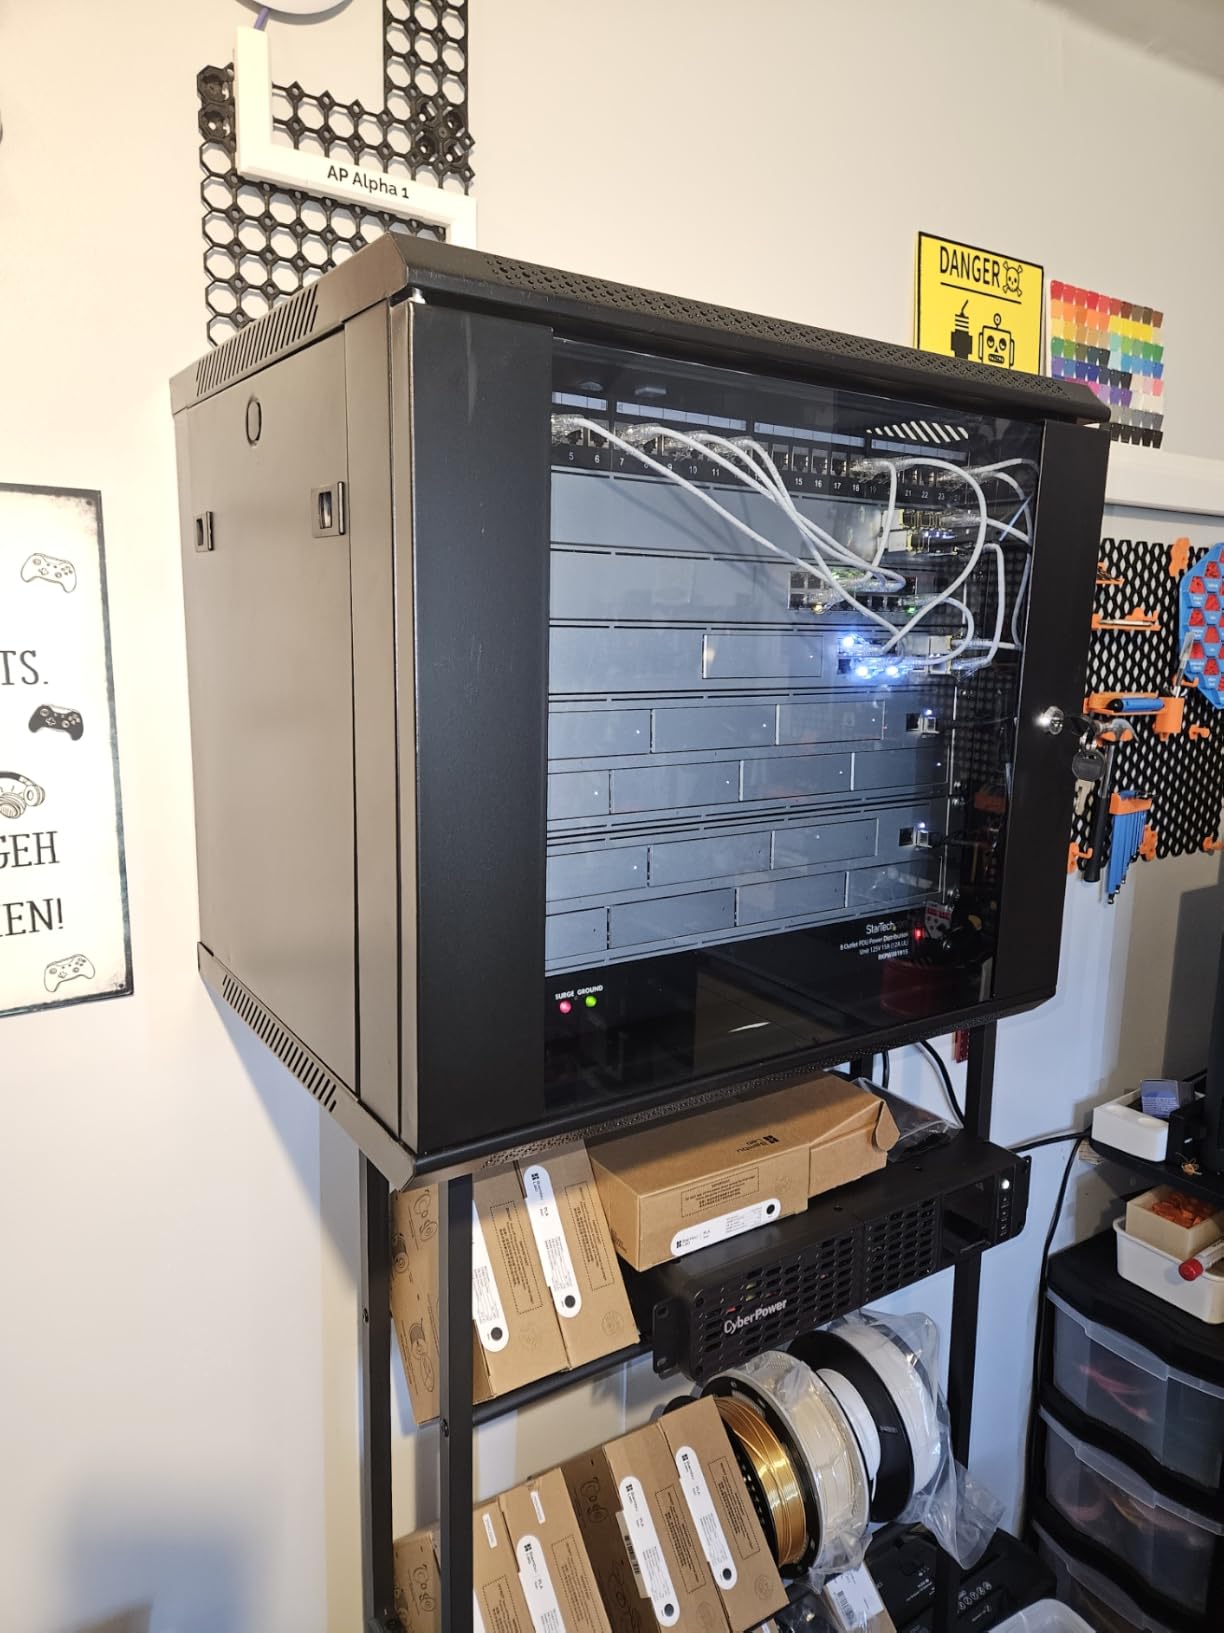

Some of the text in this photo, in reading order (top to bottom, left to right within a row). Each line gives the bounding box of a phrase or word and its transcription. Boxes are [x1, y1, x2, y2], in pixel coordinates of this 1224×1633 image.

[327, 165, 409, 199] AP Alpha 1
[940, 245, 1001, 288] DANGER
[568, 451, 574, 461] 5
[594, 454, 600, 464] 6
[619, 457, 625, 466] 7
[689, 465, 698, 475] 10
[795, 477, 803, 486] 15
[814, 479, 823, 489] 16
[833, 482, 842, 490] 17
[577, 985, 603, 995] GROUND
[724, 1299, 788, 1335] CyberPower
